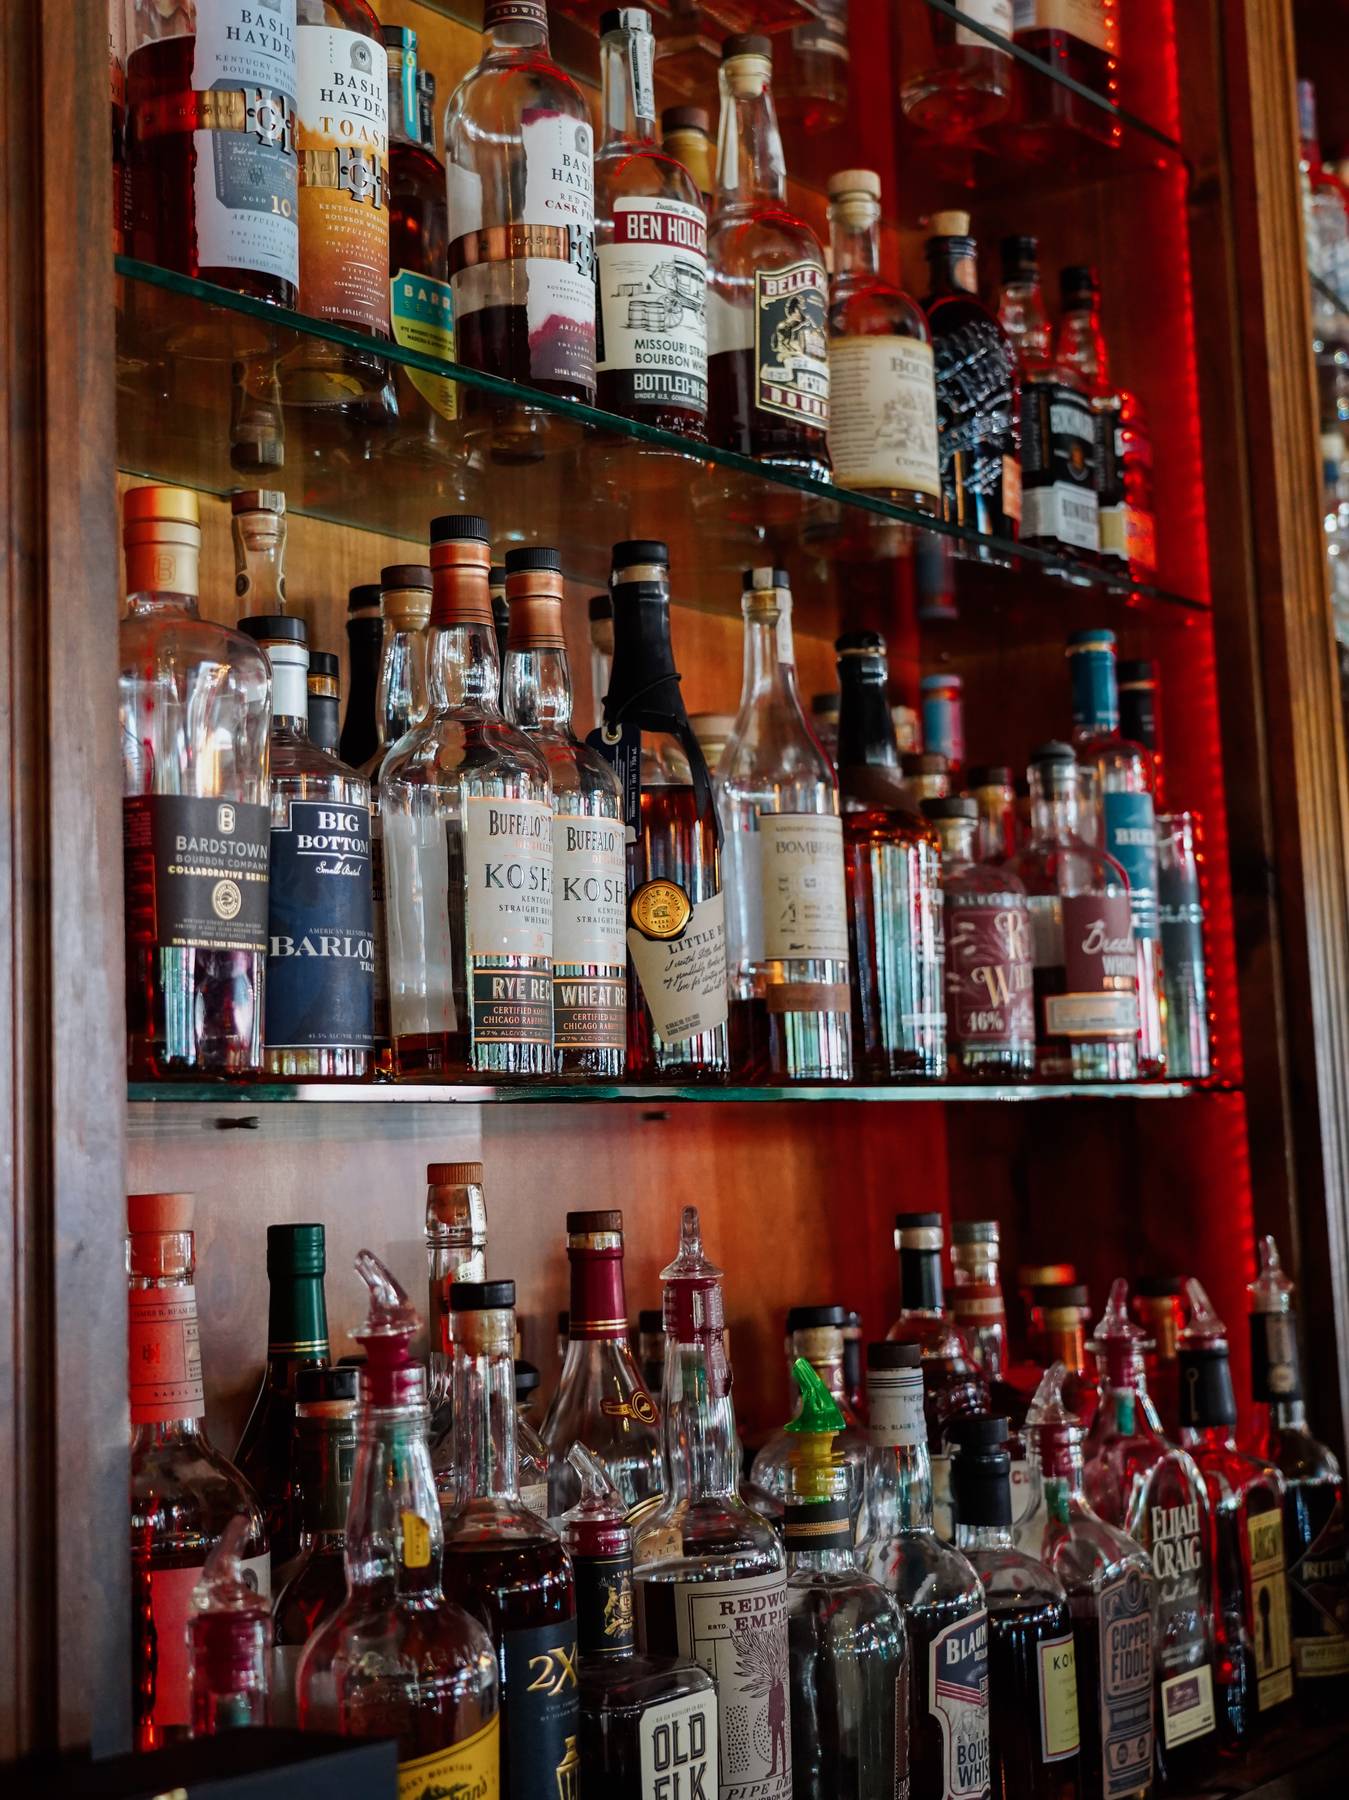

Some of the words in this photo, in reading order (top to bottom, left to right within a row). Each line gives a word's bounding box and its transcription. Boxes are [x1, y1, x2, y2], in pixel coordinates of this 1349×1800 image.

[241, 9, 292, 42] BASIL
[216, 55, 271, 71] KENTUCKY
[223, 65, 271, 80] BOURBON
[334, 72, 383, 102] BASIL
[271, 194, 292, 218] 10
[544, 199, 579, 215] CASK
[627, 213, 663, 241] BEN
[765, 269, 814, 297] BELLE
[634, 338, 688, 355] MISSOURI
[636, 352, 690, 369] BOURBON
[219, 804, 236, 835] B
[318, 811, 360, 833] BIG
[489, 809, 541, 836] BUFFALO
[175, 835, 268, 859] BARDSTOWN
[297, 834, 369, 854] BOTTOM
[566, 826, 615, 853] BUFFALO
[168, 865, 243, 880] COLLABORATIVE
[175, 854, 225, 867] BOURBON
[227, 859, 268, 872] COMPANY
[499, 904, 539, 914] STRAIGHT
[576, 915, 614, 925] STRAIGHT
[309, 927, 344, 936] AMERICAN
[666, 928, 716, 955] LITTLE
[492, 976, 527, 1000] RYE
[561, 985, 612, 1007] WHEAT
[483, 1016, 520, 1025] CHICAGO
[493, 1006, 532, 1016] CERTIFIED
[572, 1013, 608, 1022] CERTIFIED
[563, 1022, 598, 1031] CHICAGO
[1151, 1503, 1200, 1543] ELIJAH
[1152, 1536, 1201, 1580] CRAIG
[719, 1589, 786, 1616] REDWO
[527, 1642, 577, 1697] 2X
[652, 1711, 706, 1772] OLD
[727, 1783, 770, 1800] PIPE
